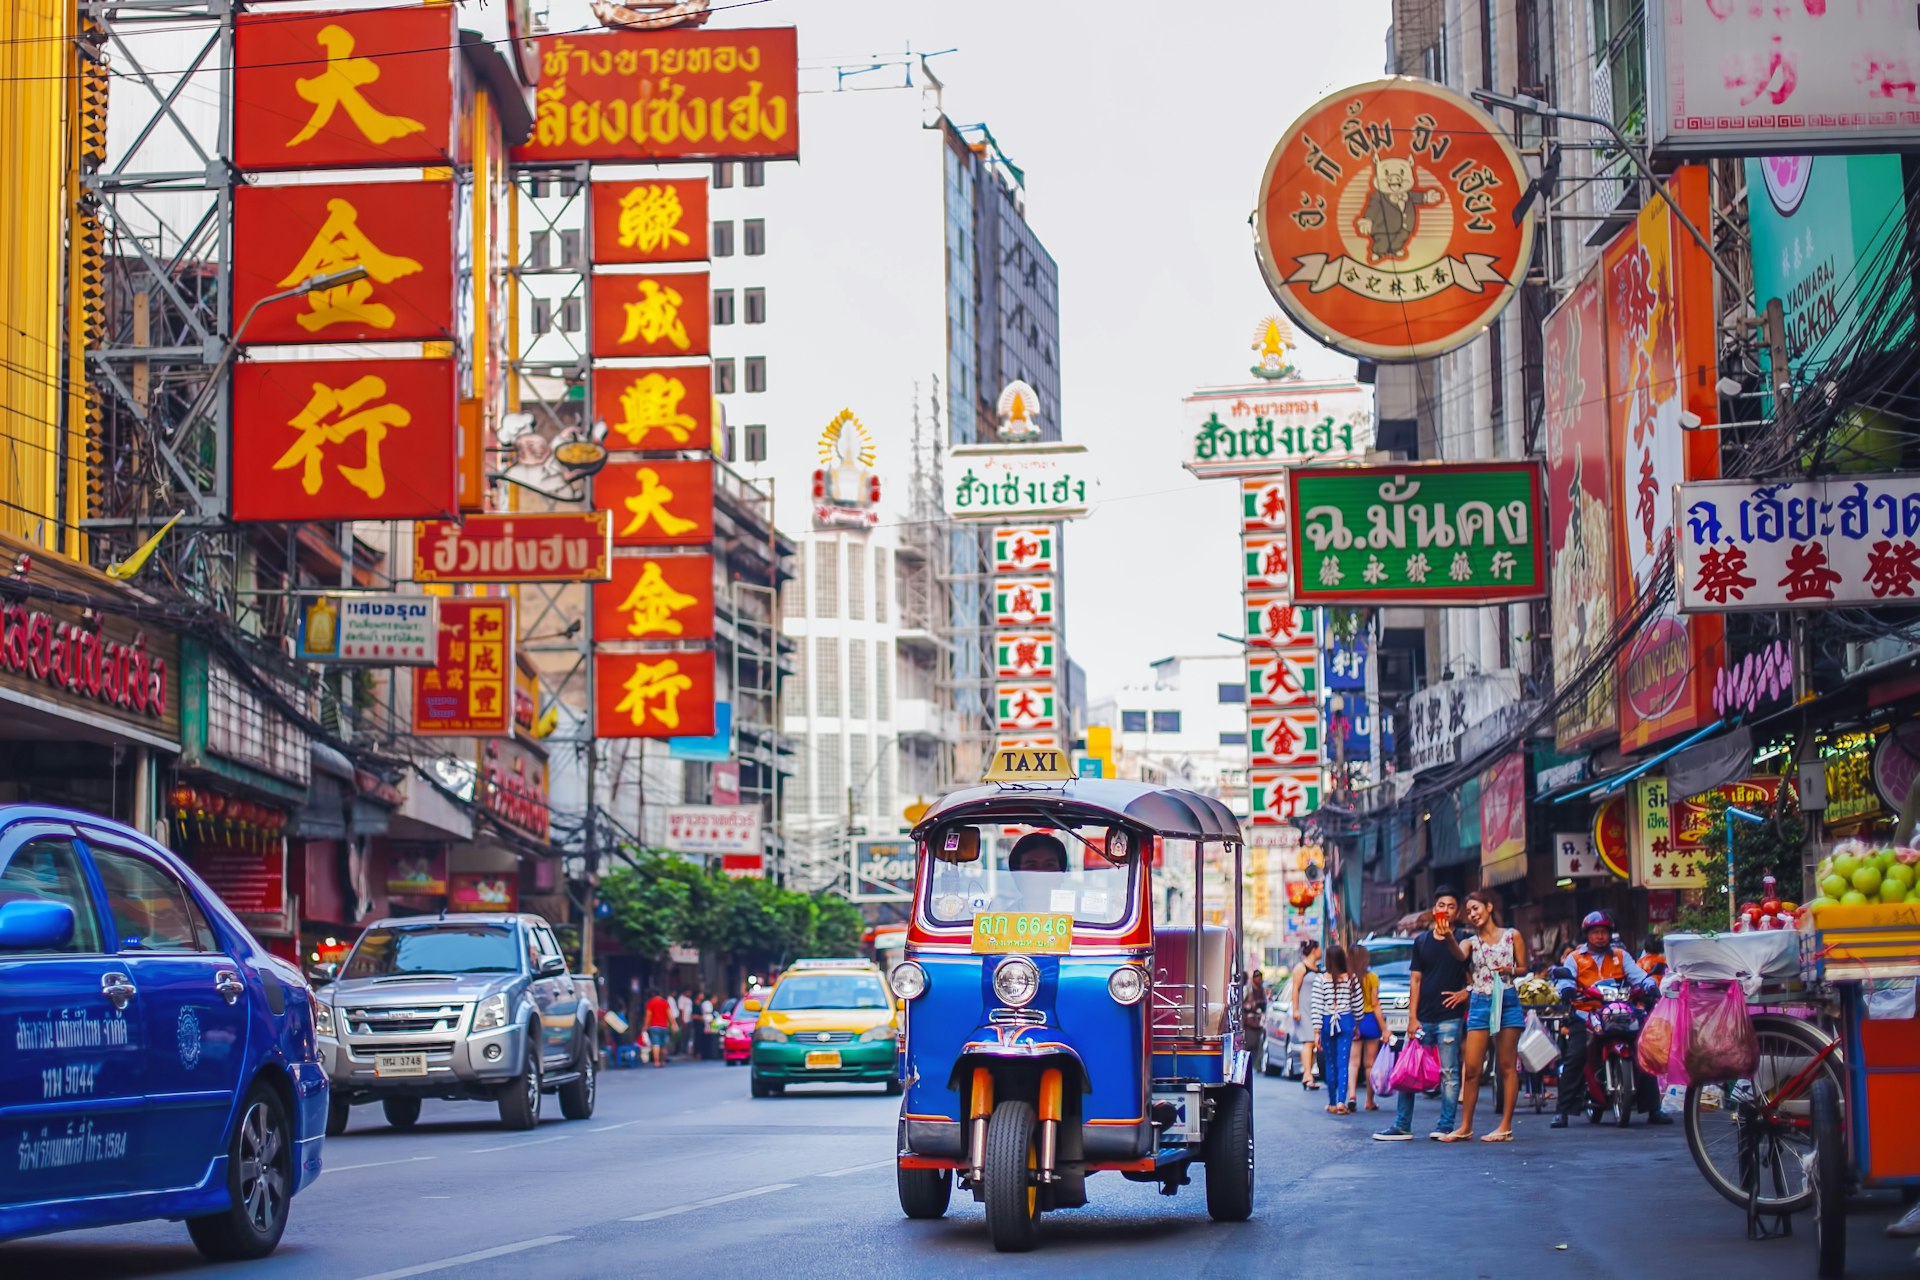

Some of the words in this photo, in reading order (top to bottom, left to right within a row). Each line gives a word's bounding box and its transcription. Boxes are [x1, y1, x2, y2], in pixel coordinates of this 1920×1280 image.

[543, 38, 760, 76] ห้างขายทอง
[1342, 99, 1394, 160] ลิ้ม
[272, 23, 426, 499] 大金行
[1786, 255, 1835, 314] YAOWARAJ
[1786, 283, 1838, 360] NGKOK
[1195, 411, 1353, 460] ฮั่วเซ่งเฮง
[956, 468, 1086, 507] ฮั่วเซ่งเฮง
[1305, 475, 1528, 551] ฉ.มั่นคง
[347, 603, 427, 621] แสงอรุณ
[1010, 536, 1040, 748] 和成興大
[1002, 751, 1058, 772] TAXI
[979, 915, 1008, 936] สก
[1016, 916, 1068, 936] 6646
[103, 1008, 128, 1046] จำกัด
[65, 1063, 94, 1095] 9044
